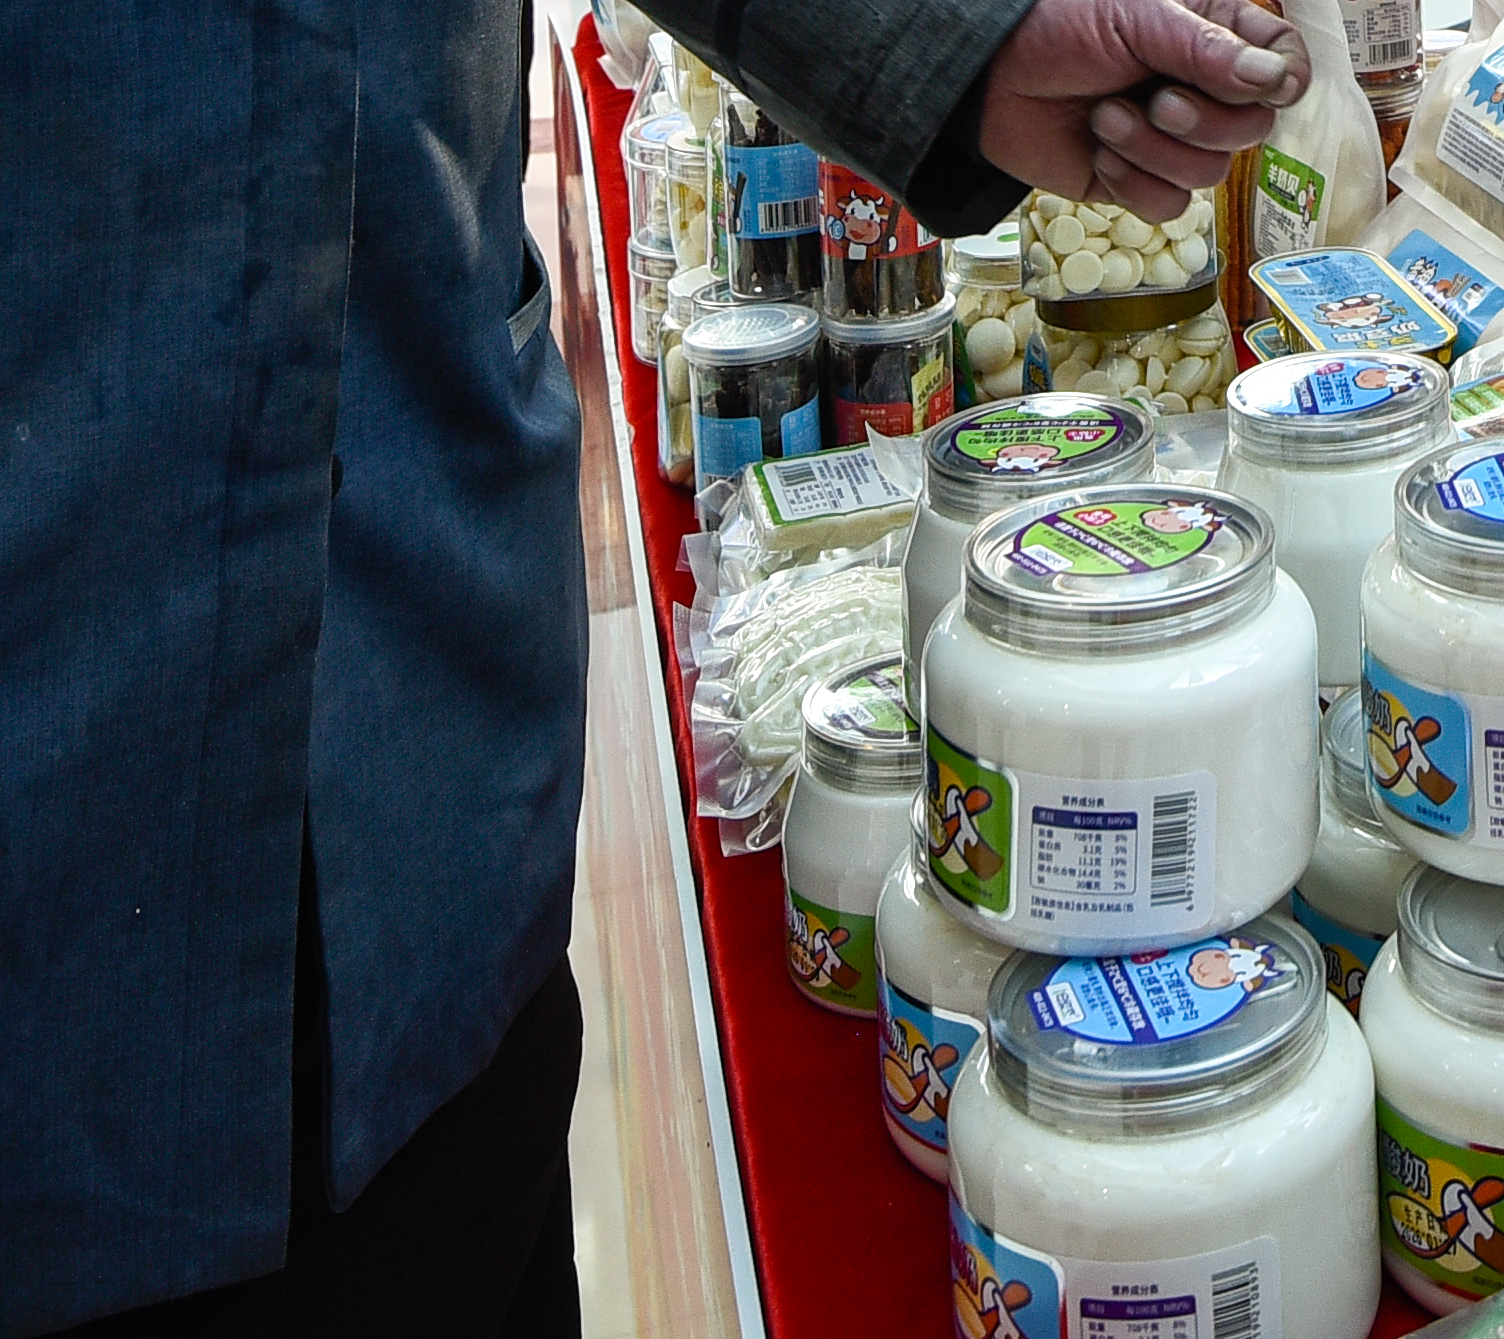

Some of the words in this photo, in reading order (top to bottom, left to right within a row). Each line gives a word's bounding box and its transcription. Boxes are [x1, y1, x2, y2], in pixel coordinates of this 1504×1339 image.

[1062, 795, 1105, 808] 营养成分表
[1038, 840, 1061, 851] 蛋白质
[1038, 852, 1053, 861] 脂肪
[1037, 864, 1076, 877] 碳水化合物
[1111, 1284, 1159, 1296] 营养成分表
